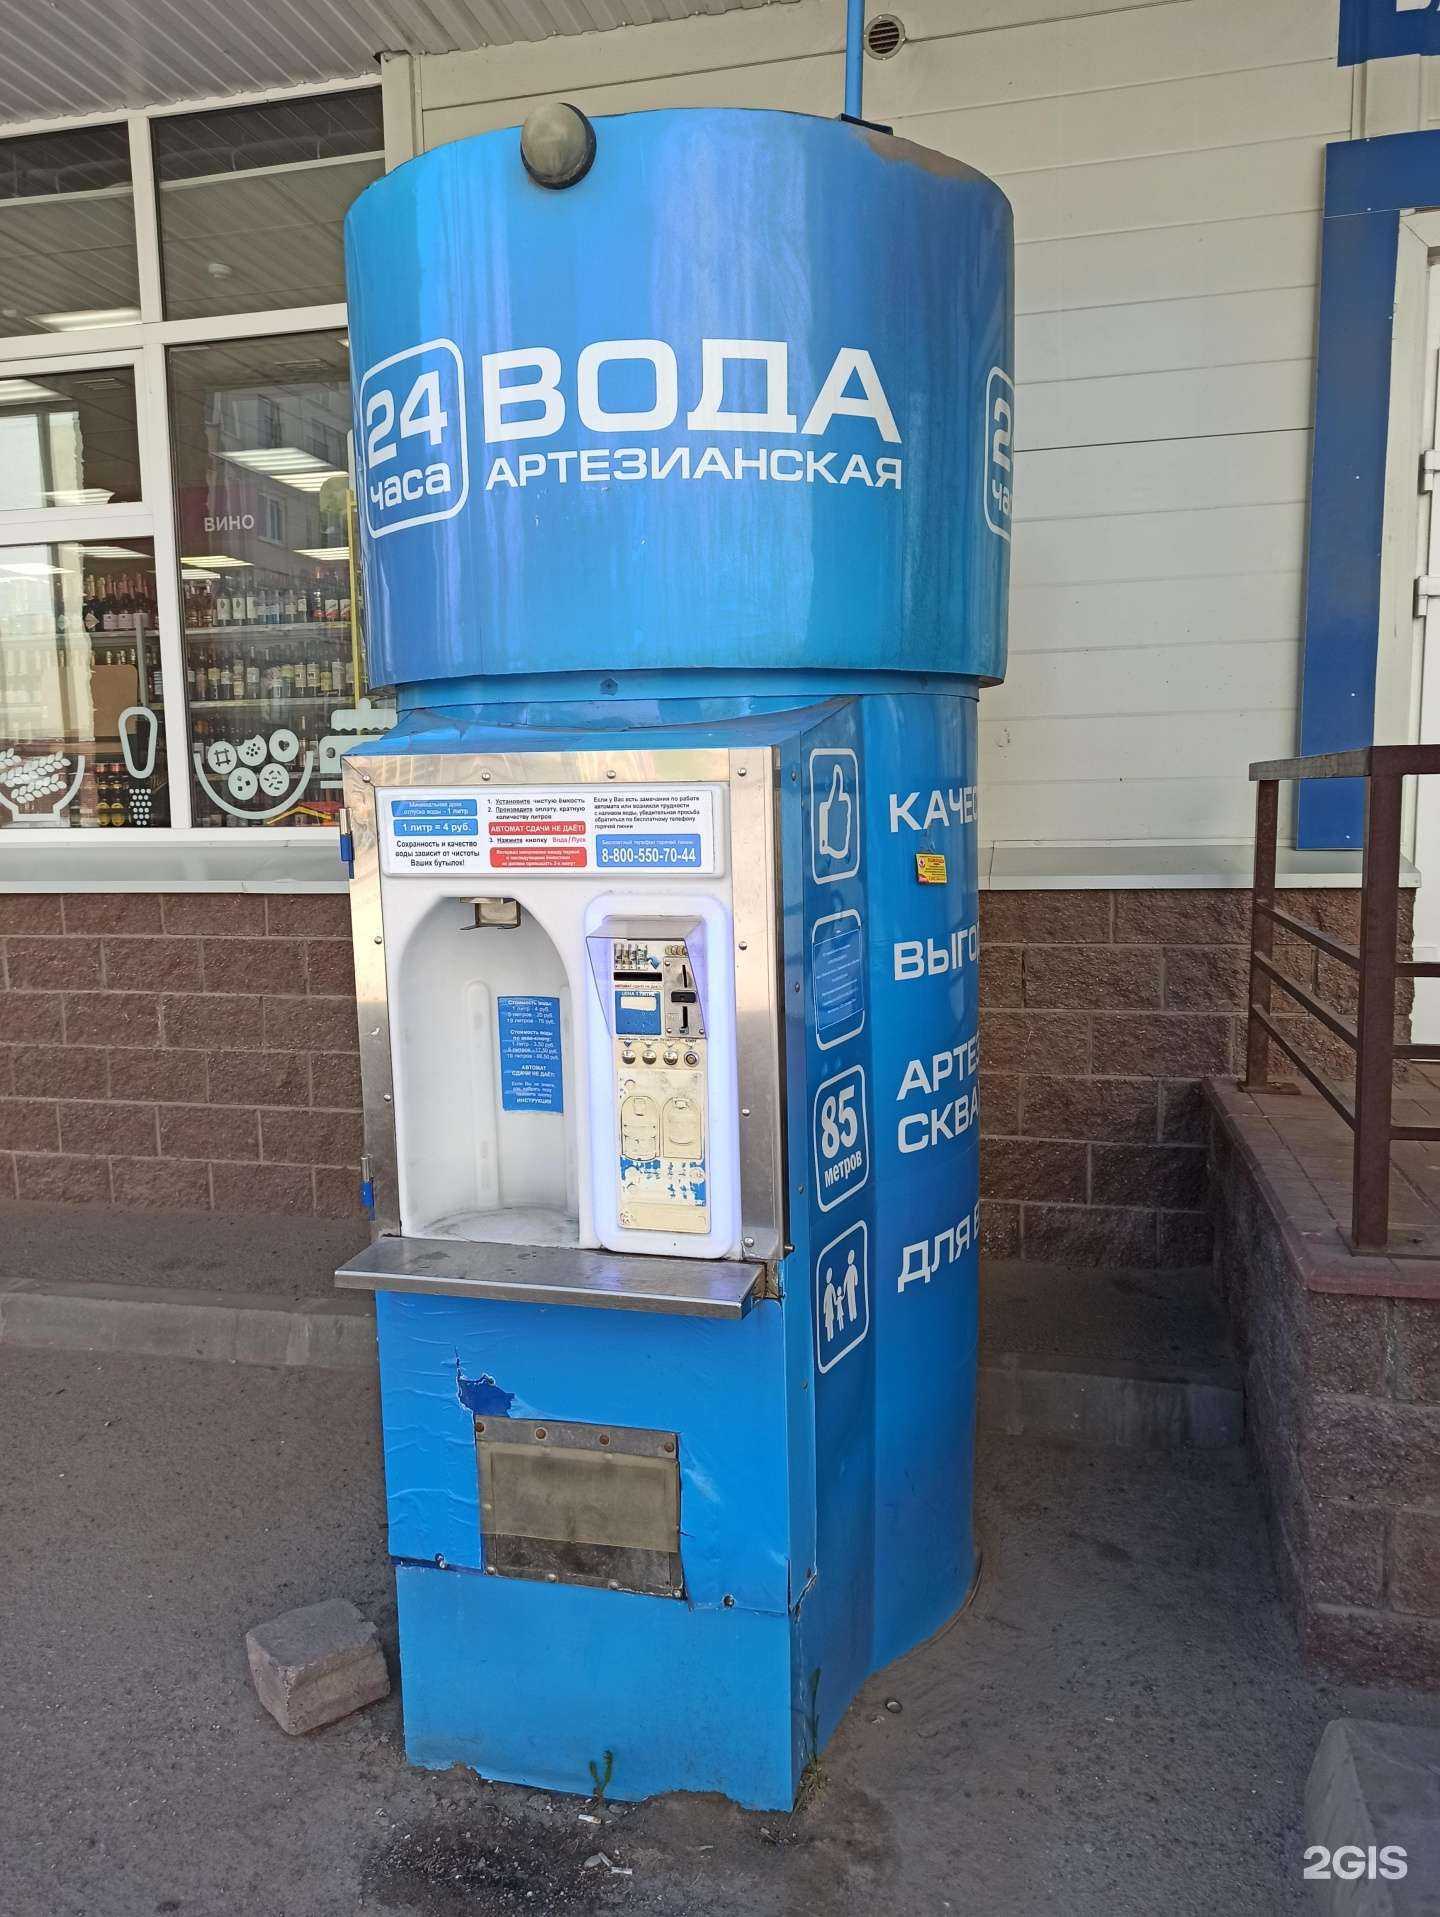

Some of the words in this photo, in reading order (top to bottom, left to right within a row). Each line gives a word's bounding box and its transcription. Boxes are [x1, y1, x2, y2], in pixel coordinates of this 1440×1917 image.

[482, 338, 902, 444] ВОДА
[367, 370, 448, 469] 24
[370, 462, 451, 511] часа
[485, 447, 902, 491] АРТЕЗИАНСКАЯ
[204, 514, 254, 532] ВИНО
[396, 840, 440, 849] Сохранность
[410, 824, 433, 833] литр
[443, 822, 449, 832] 4
[451, 822, 472, 833] руб.
[490, 825, 525, 833] АВТОМАТ
[451, 849, 480, 857] чистоты
[601, 847, 697, 863] 8-800-550-70-44
[821, 1085, 858, 1159] 85
[824, 1151, 863, 1188] метров
[898, 1215, 971, 1293] ДЛЯ
